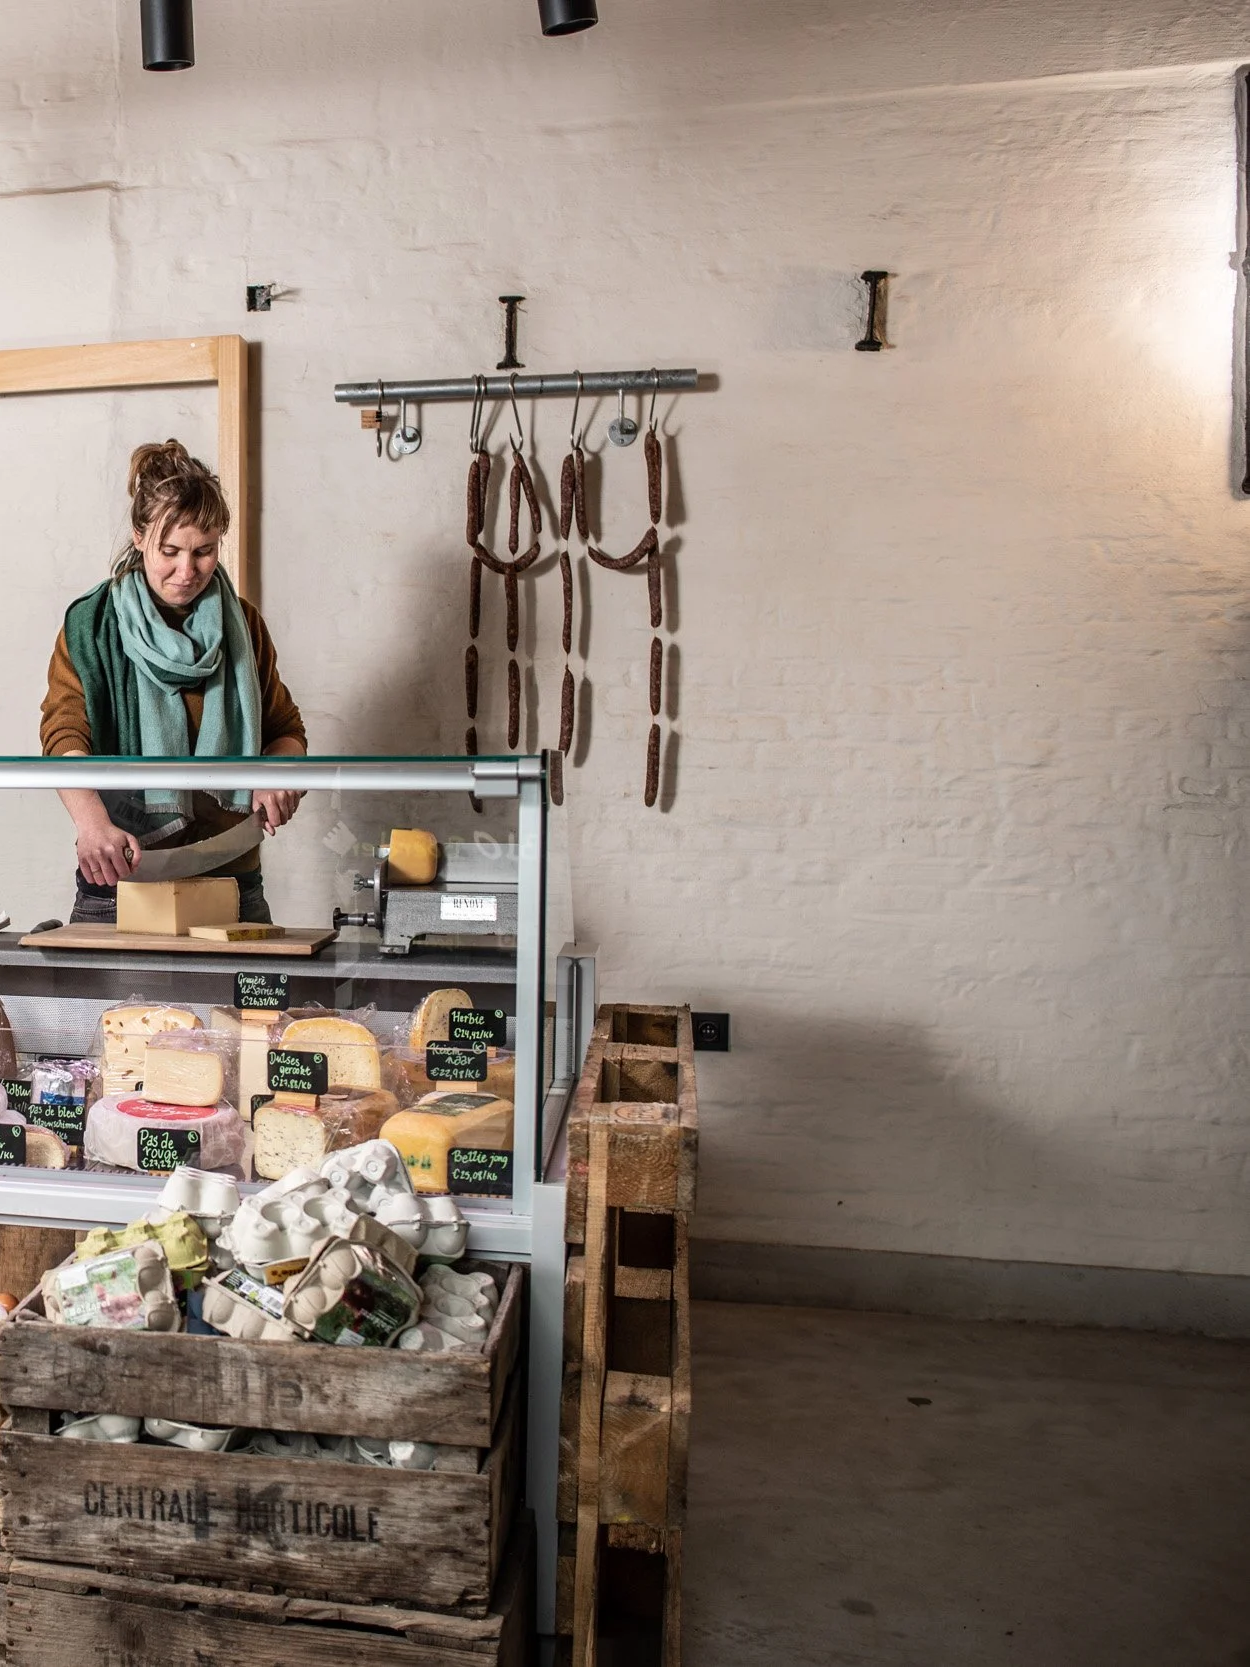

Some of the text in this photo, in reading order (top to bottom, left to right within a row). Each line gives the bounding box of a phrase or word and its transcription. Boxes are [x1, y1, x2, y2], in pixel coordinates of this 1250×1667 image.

[451, 1011, 485, 1025] Herbie
[45, 1106, 55, 1116] de
[57, 1106, 76, 1118] bleu
[140, 1129, 158, 1148] Pas
[161, 1132, 174, 1149] de
[143, 1146, 178, 1163] rouge
[489, 1152, 508, 1169] jong
[83, 1480, 380, 1543] CENTRALE HORTICOLE
